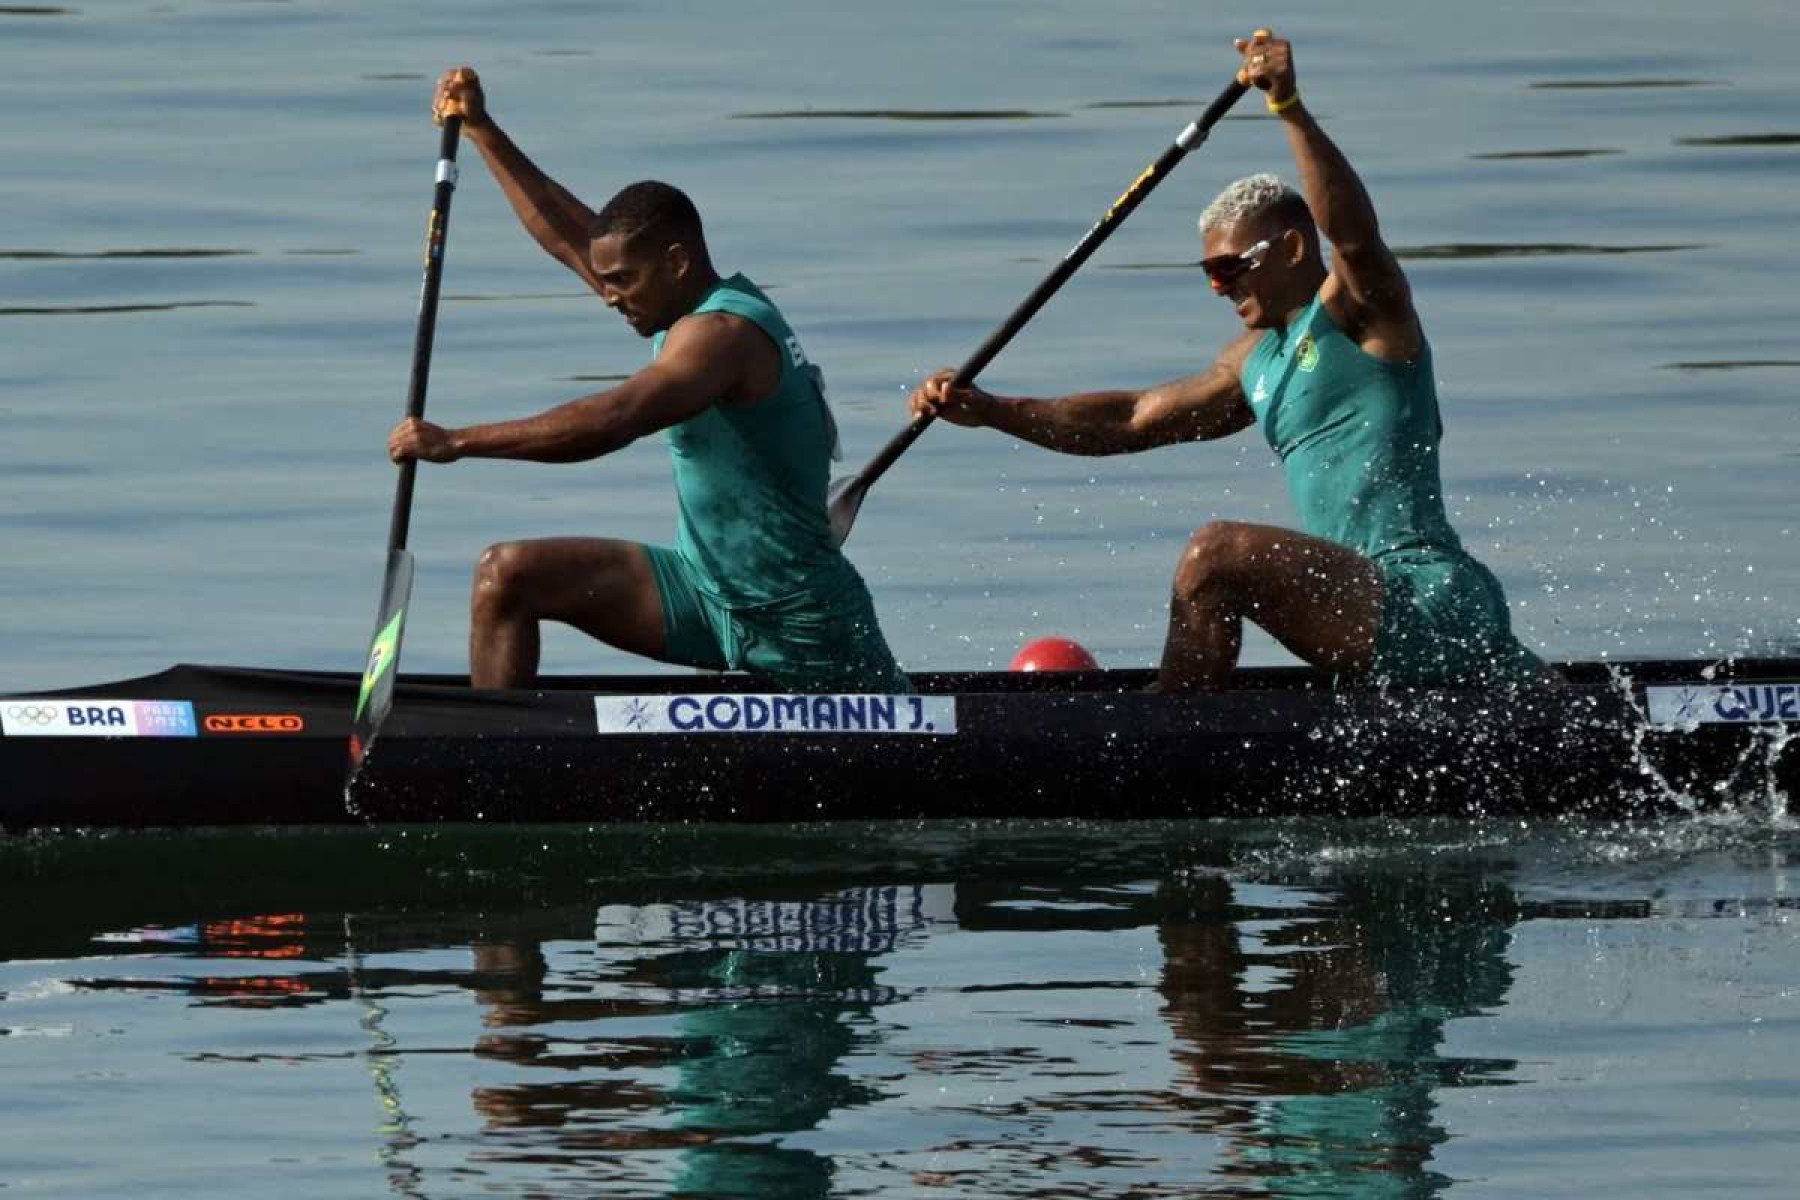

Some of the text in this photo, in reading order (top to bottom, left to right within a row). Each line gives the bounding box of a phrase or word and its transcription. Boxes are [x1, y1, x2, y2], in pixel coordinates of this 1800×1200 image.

[67, 707, 126, 726] BRA
[668, 696, 934, 732] GODMANN J.
[1714, 687, 1800, 720] QUE
